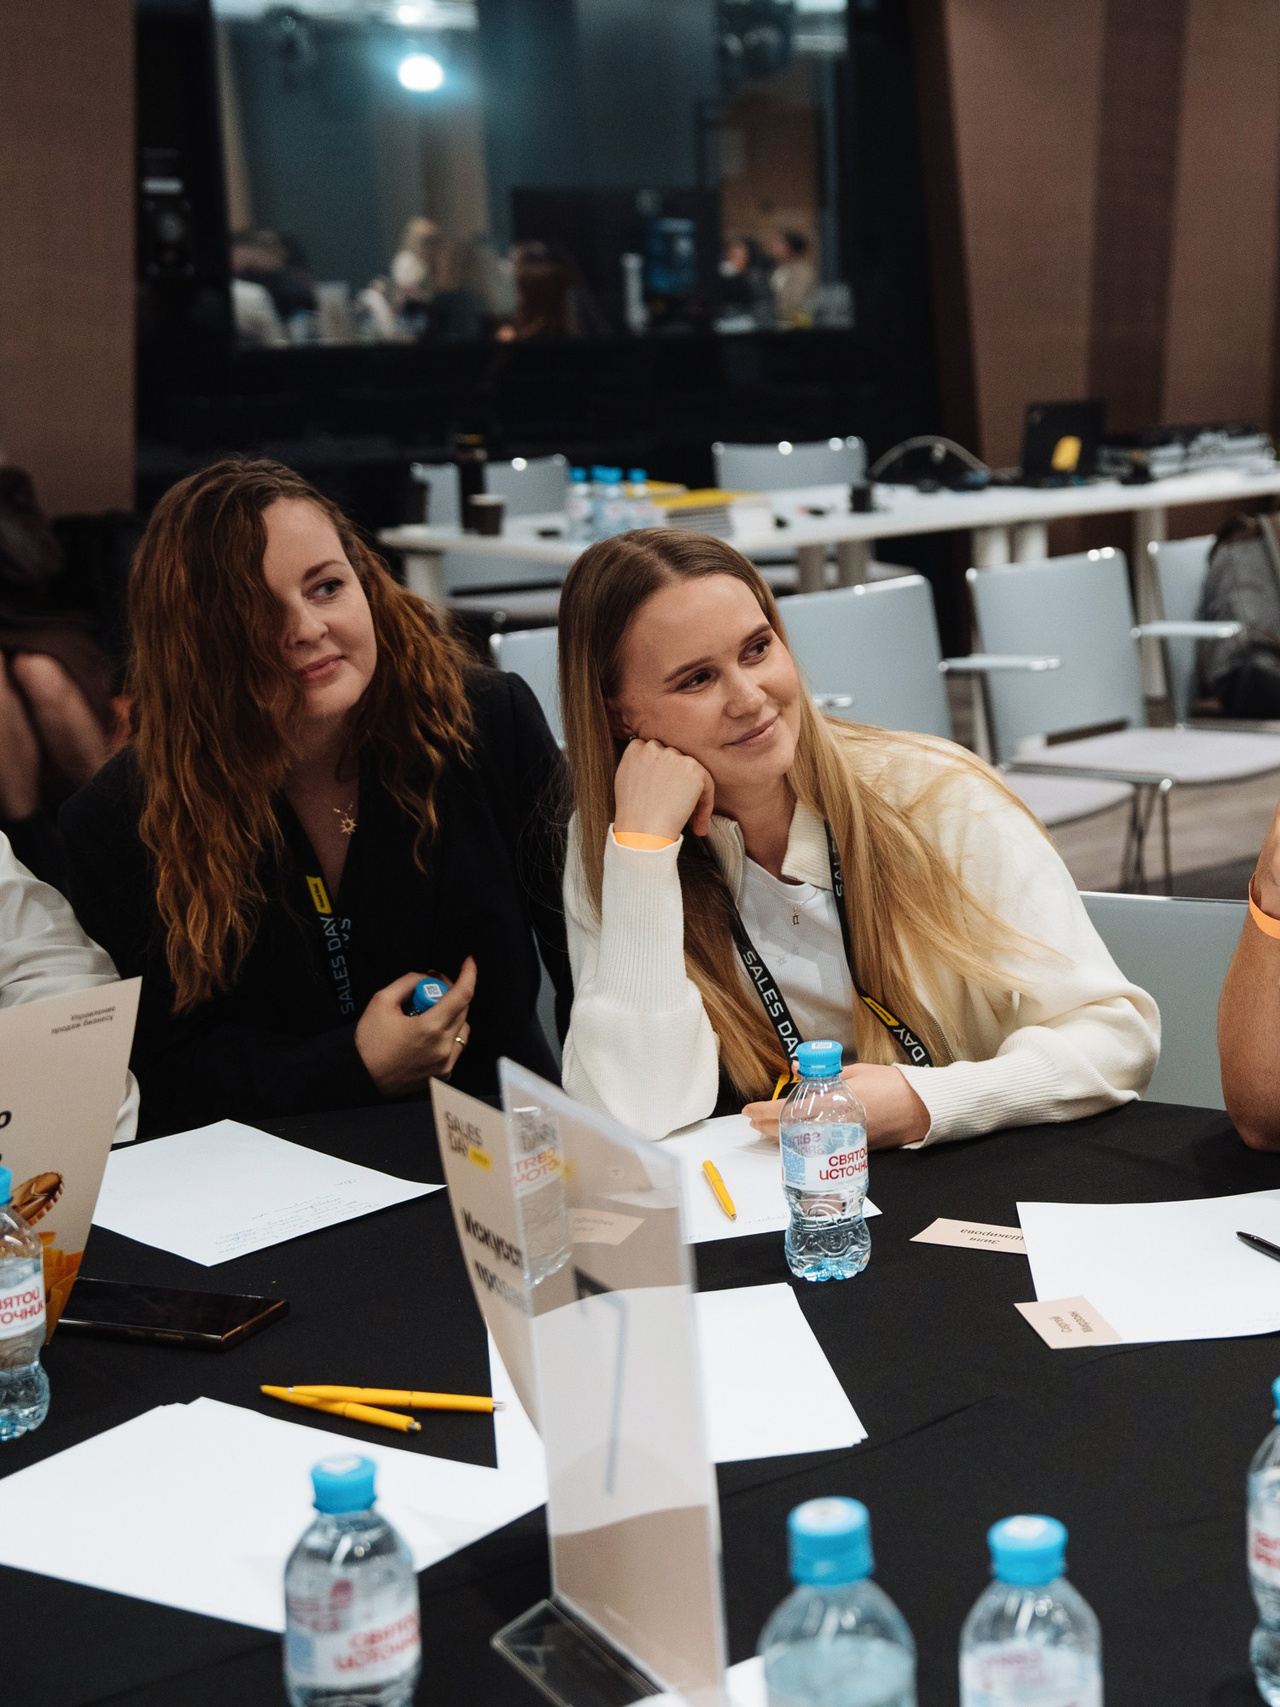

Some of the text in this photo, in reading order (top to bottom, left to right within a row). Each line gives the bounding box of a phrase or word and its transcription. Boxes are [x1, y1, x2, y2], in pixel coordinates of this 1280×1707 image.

[320, 916, 342, 951] DAY
[331, 955, 355, 1015] SALES
[743, 950, 784, 1018] SALES
[893, 1028, 926, 1062] DAY
[819, 1162, 869, 1180] ИСТОЧН
[828, 1147, 868, 1167] СВЯТО
